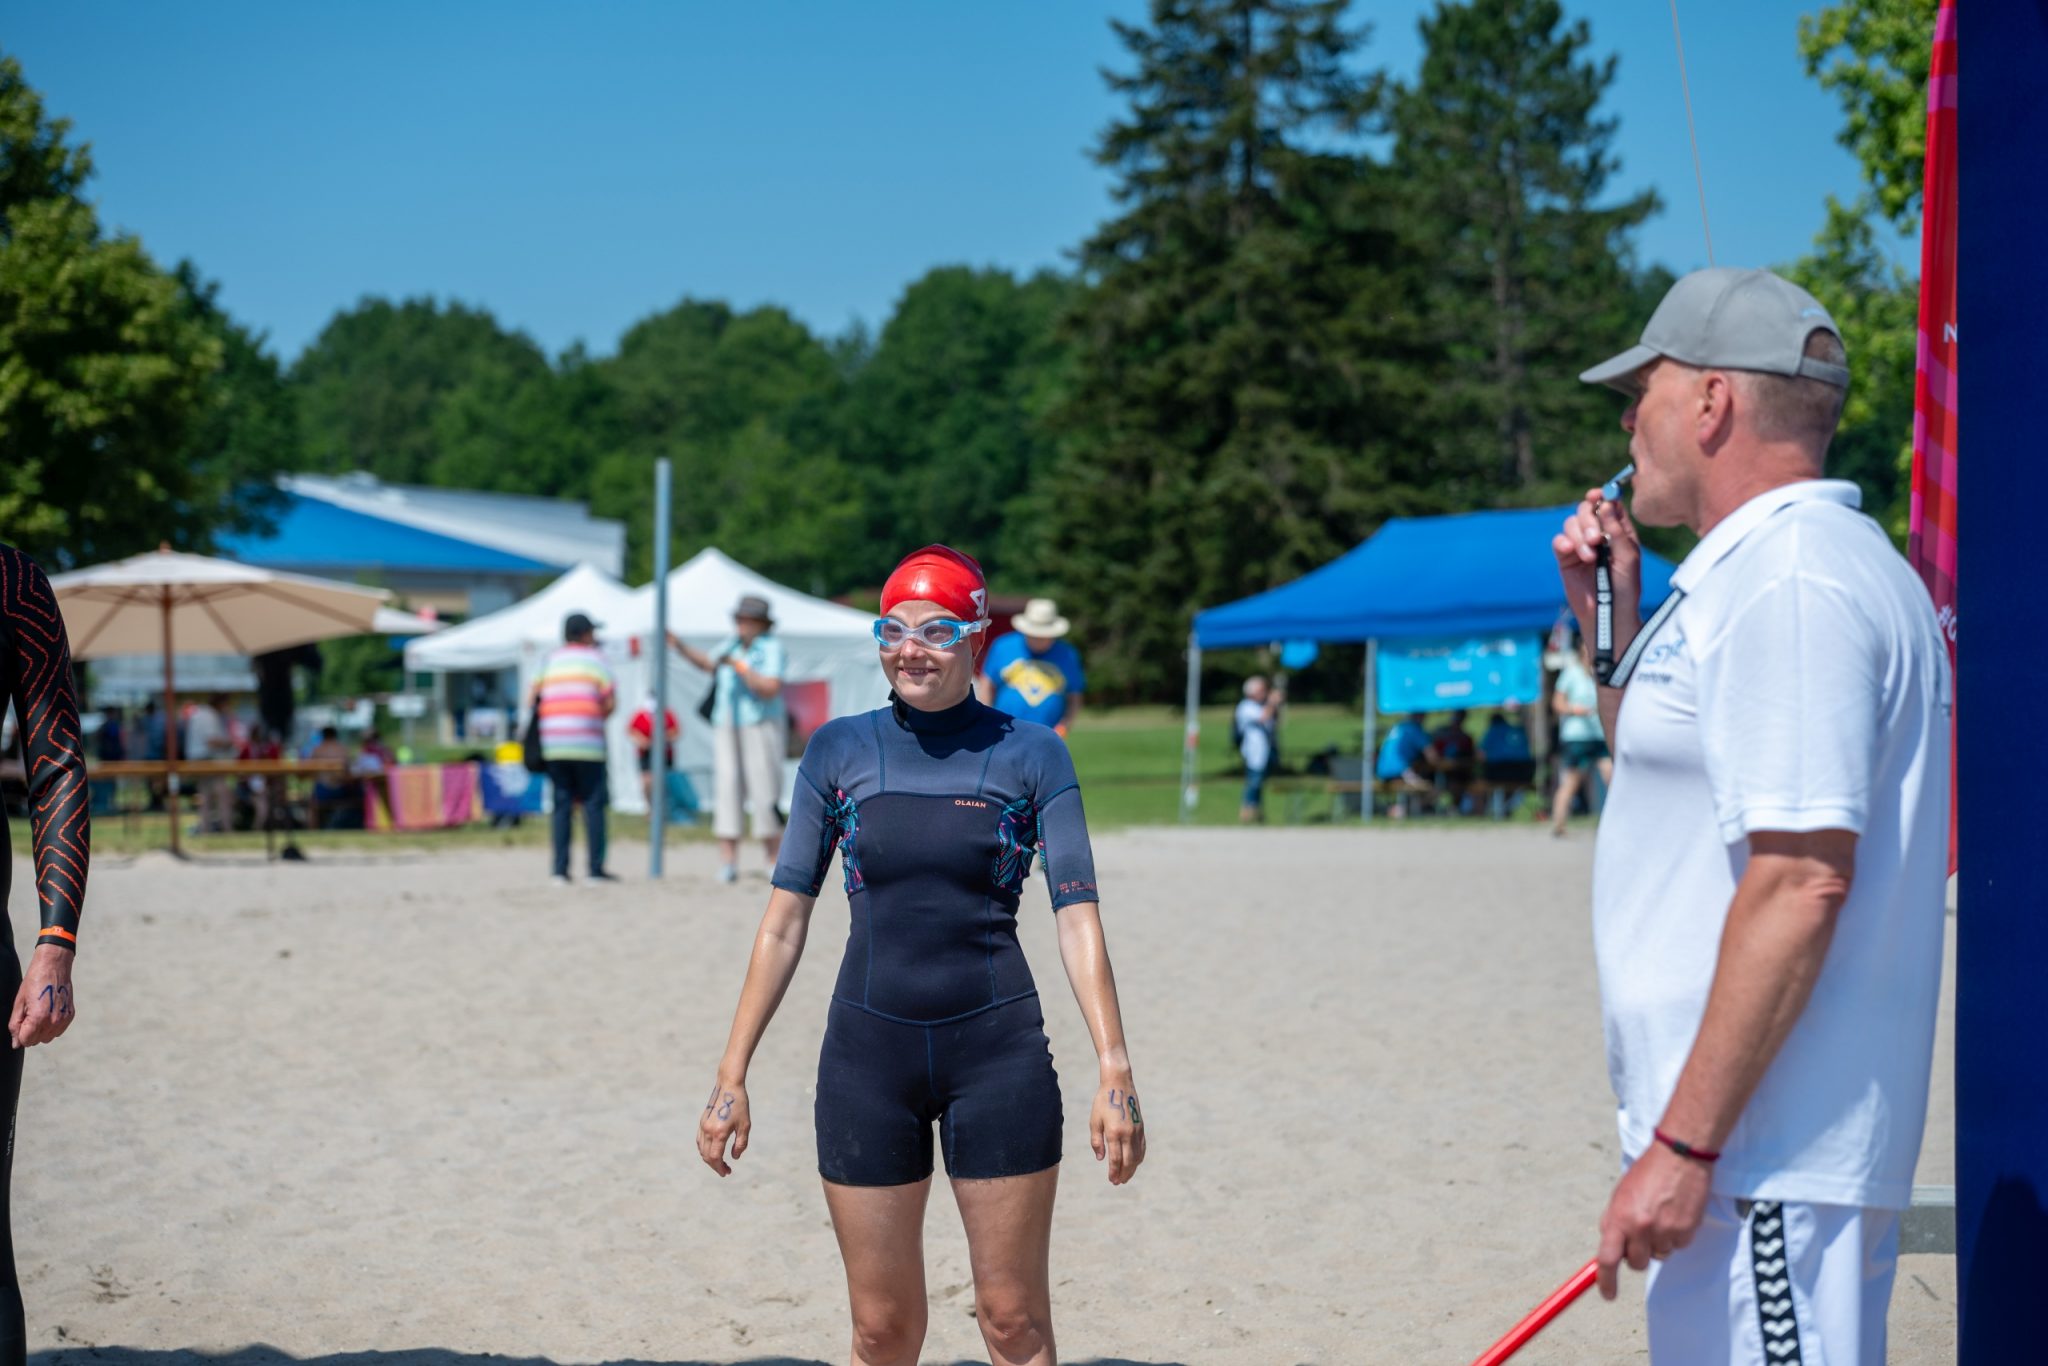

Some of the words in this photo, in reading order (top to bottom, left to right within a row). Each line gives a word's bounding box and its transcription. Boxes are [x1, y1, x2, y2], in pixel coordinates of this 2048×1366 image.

[954, 799, 986, 808] OLAIAN
[706, 1085, 735, 1121] 48
[1109, 1089, 1140, 1124] 48
